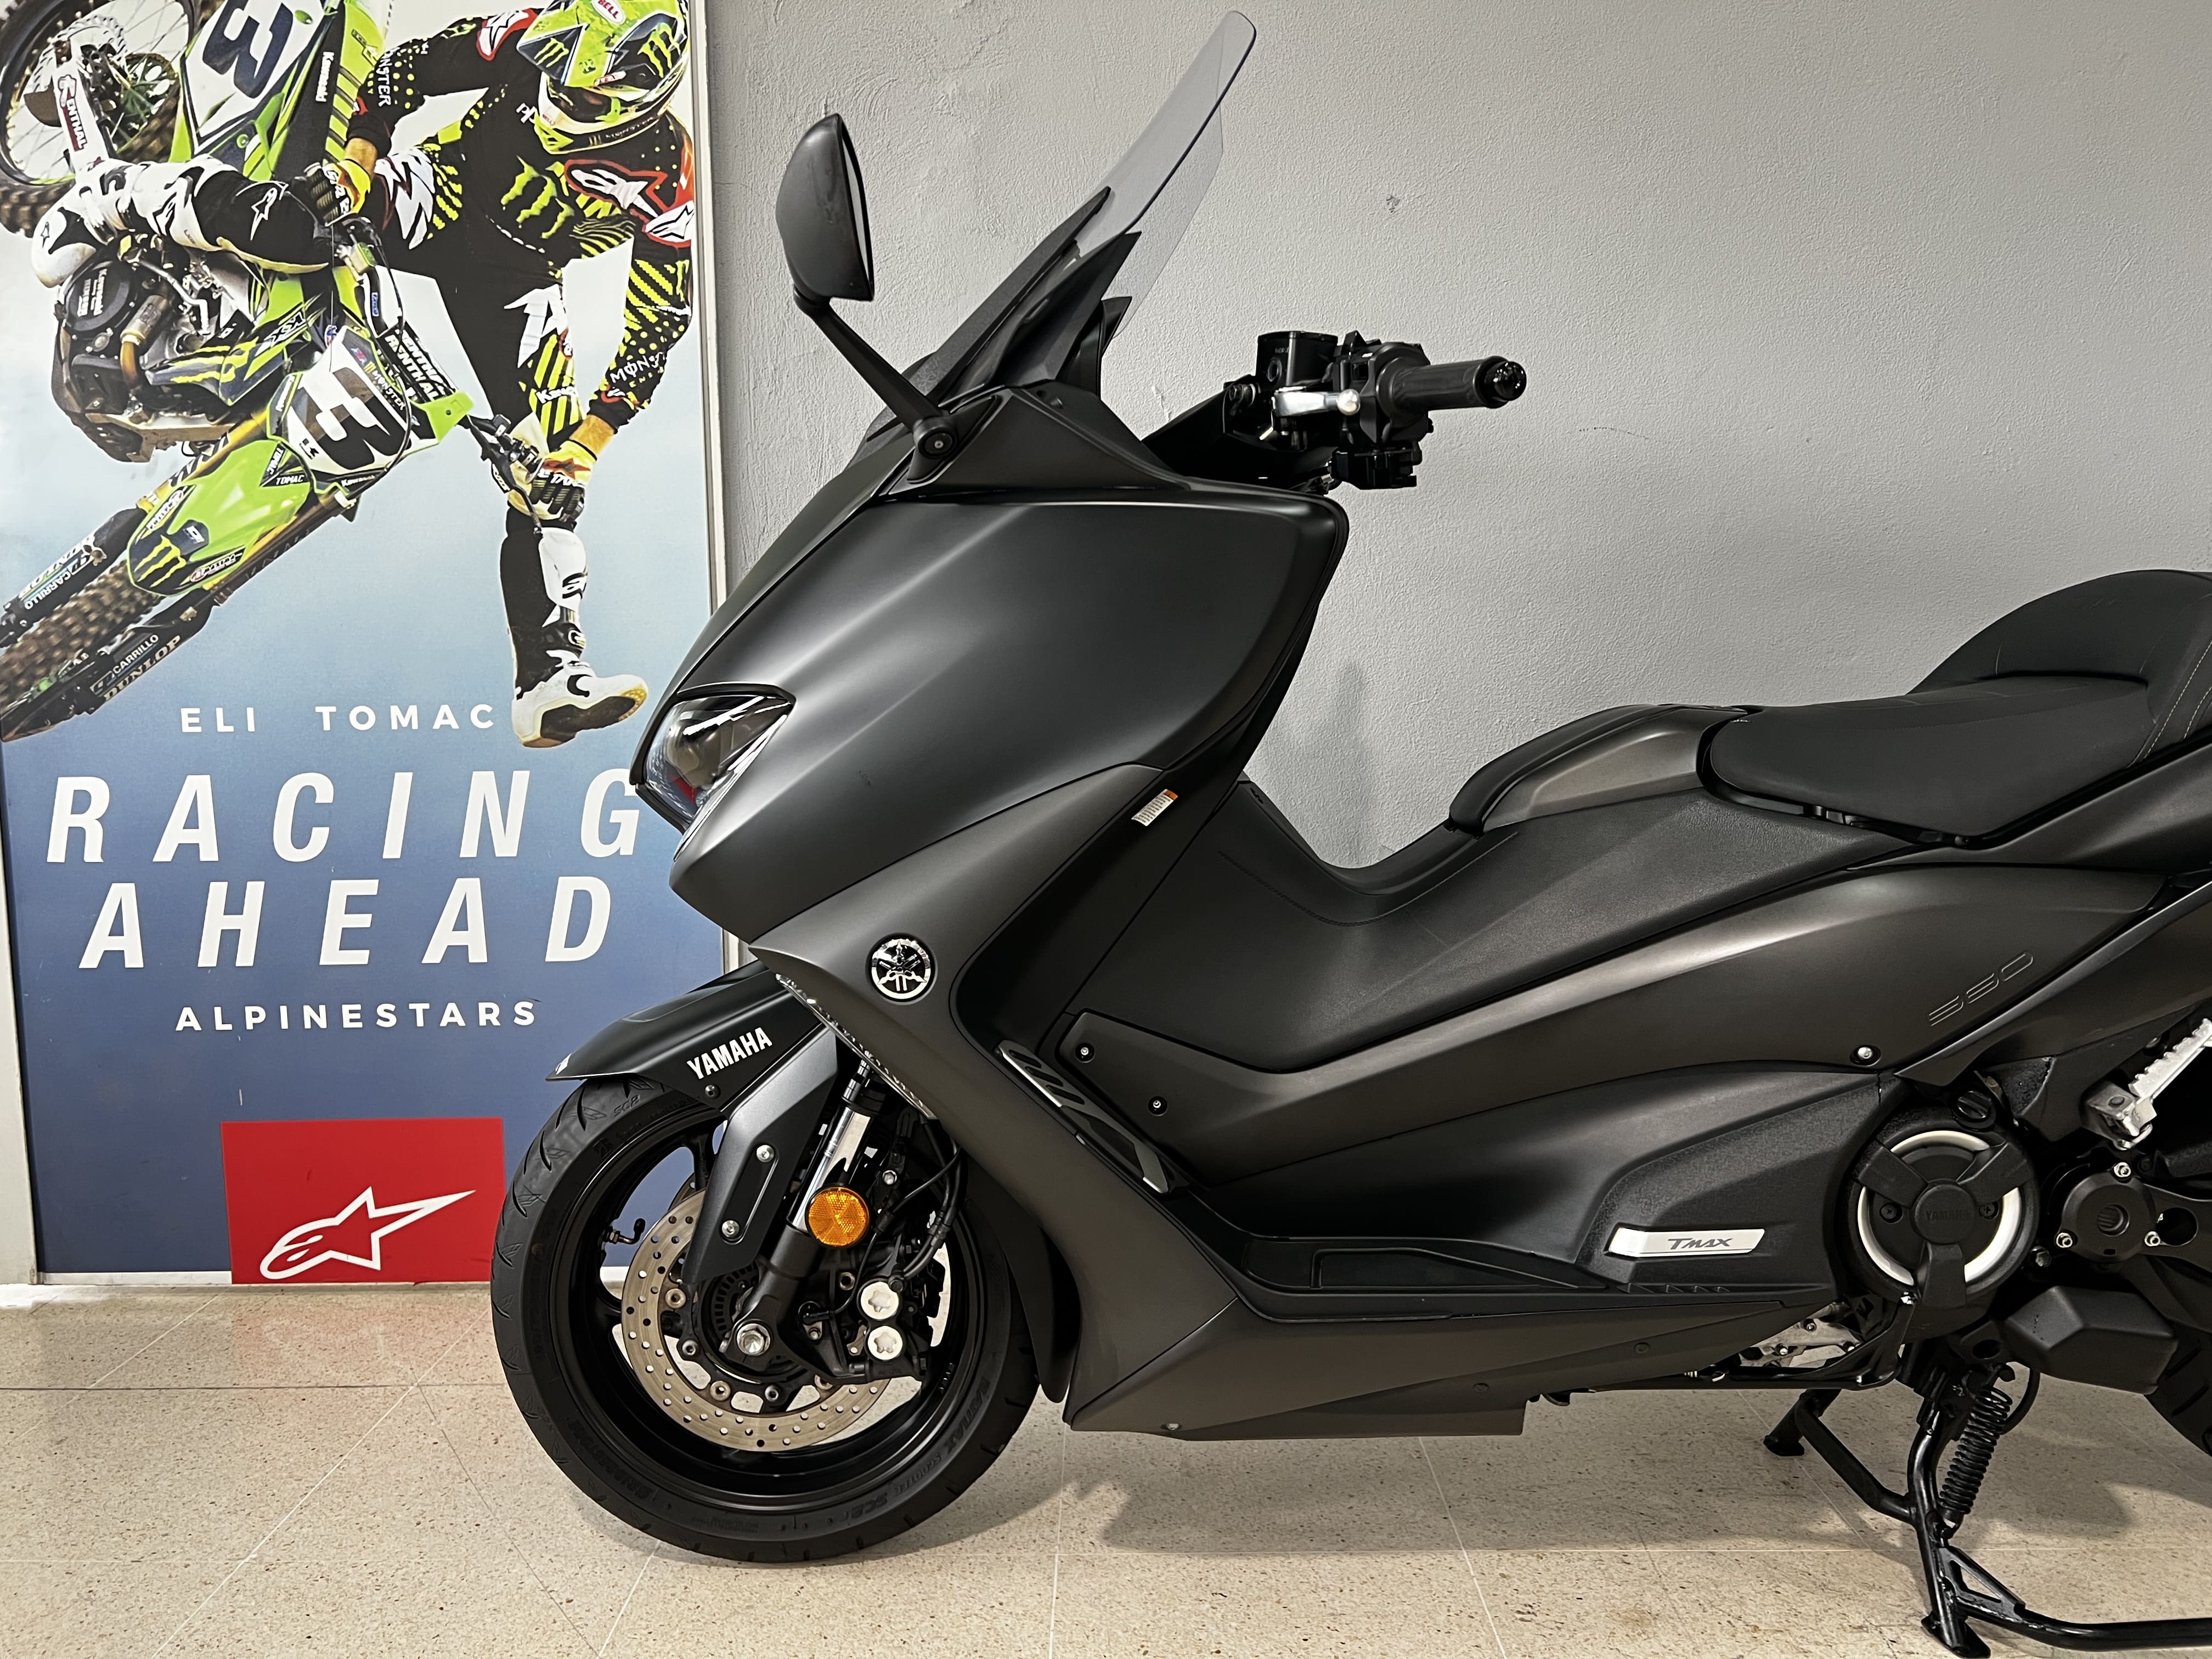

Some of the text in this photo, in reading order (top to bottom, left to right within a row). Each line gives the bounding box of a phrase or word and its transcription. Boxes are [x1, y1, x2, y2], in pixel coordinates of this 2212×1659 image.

[597, 0, 619, 19] BELL
[58, 74, 87, 150] RENTHAL
[290, 366, 412, 471] 3
[275, 475, 305, 486] TOMAC
[24, 571, 71, 610] CARRILLO
[104, 635, 181, 701] DUNLOP
[112, 634, 159, 675] CARRILLO
[180, 704, 494, 733] ELI TOMAC
[47, 769, 641, 863] RACING
[79, 876, 611, 969] AHEAD
[176, 1001, 536, 1031] ALPINESTARS
[686, 1027, 773, 1080] YAMAHA
